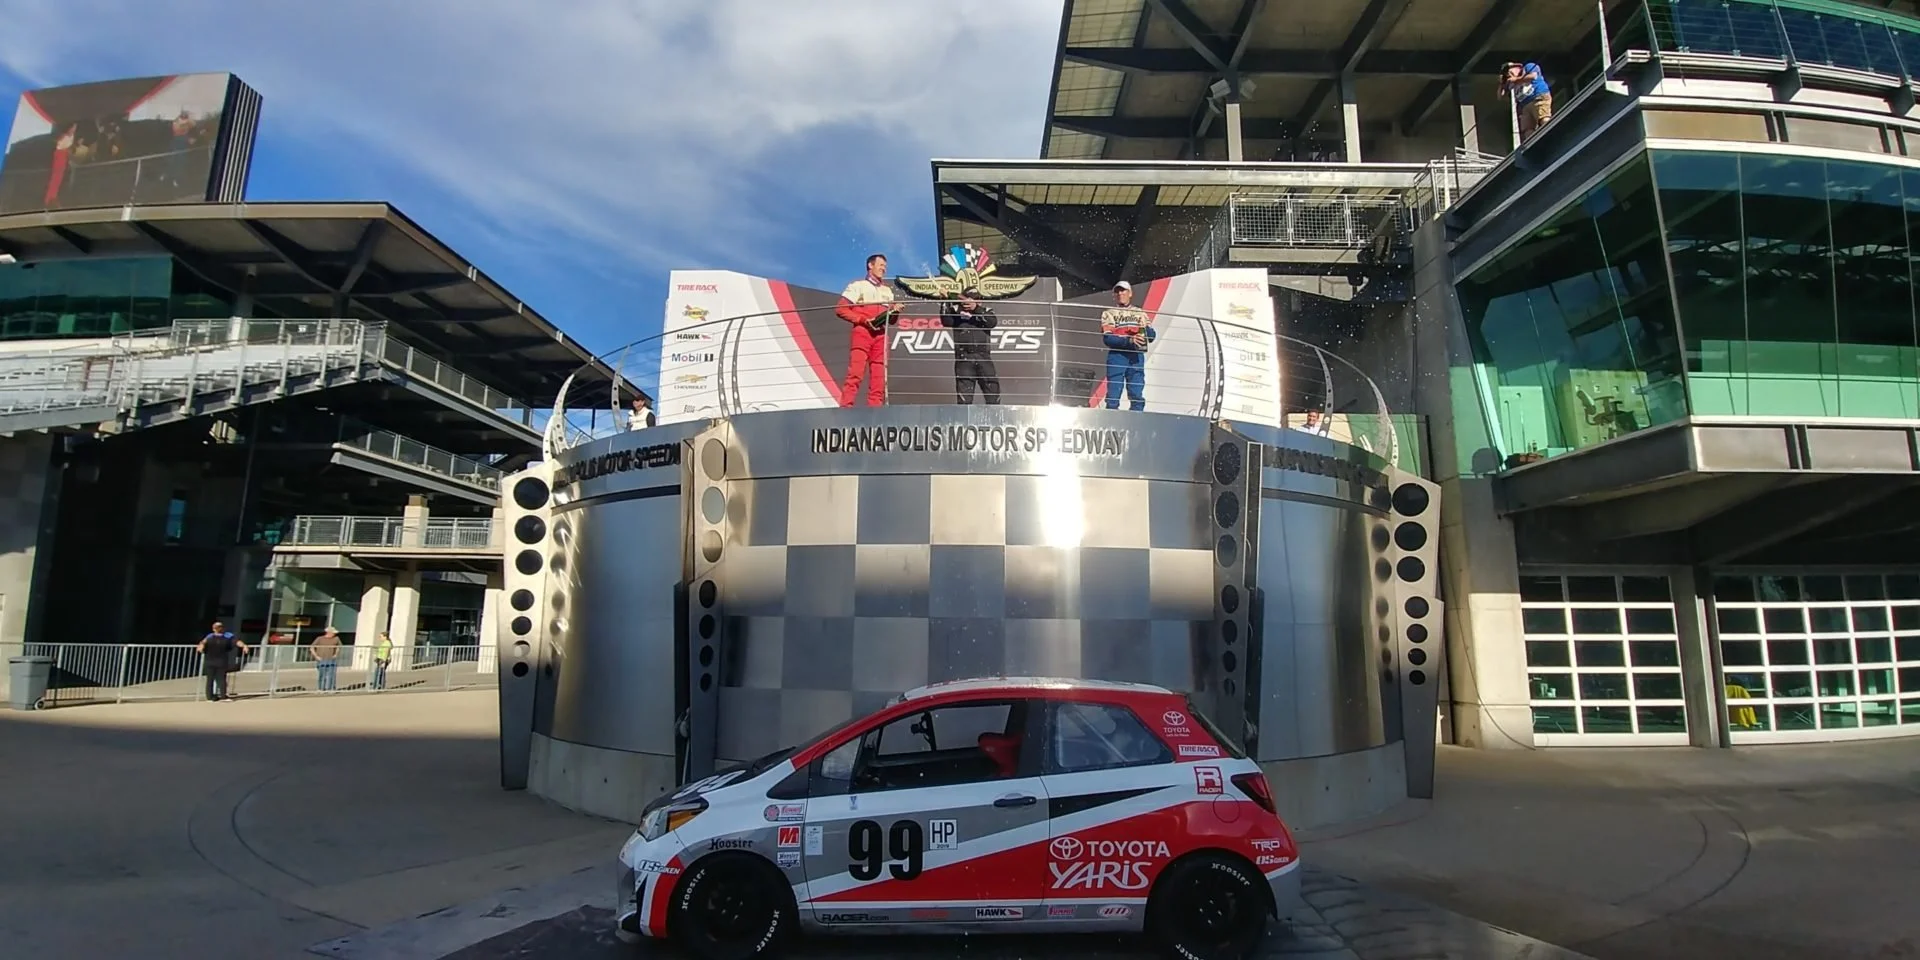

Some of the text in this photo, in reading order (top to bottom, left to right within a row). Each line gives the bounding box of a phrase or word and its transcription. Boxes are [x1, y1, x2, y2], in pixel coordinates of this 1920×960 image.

[696, 284, 718, 293] RACK
[915, 283, 959, 291] INDIANPOLIS
[897, 317, 943, 330] SCC
[891, 326, 1046, 354] RUNFFS
[671, 353, 702, 362] Mobil
[811, 425, 1125, 455] INDIANAPOLIS MOTOR SPEDWAY
[1197, 746, 1218, 756] RACK
[932, 822, 955, 843] HP
[708, 837, 753, 850] Hoosier
[848, 819, 924, 881] 99
[1086, 840, 1171, 857] TOYOTA
[658, 866, 681, 875] GIKEN
[1211, 862, 1251, 886] Hoosier
[681, 868, 706, 911] Hoosier
[822, 913, 890, 921] RACER.com
[756, 909, 780, 952] Hoosier
